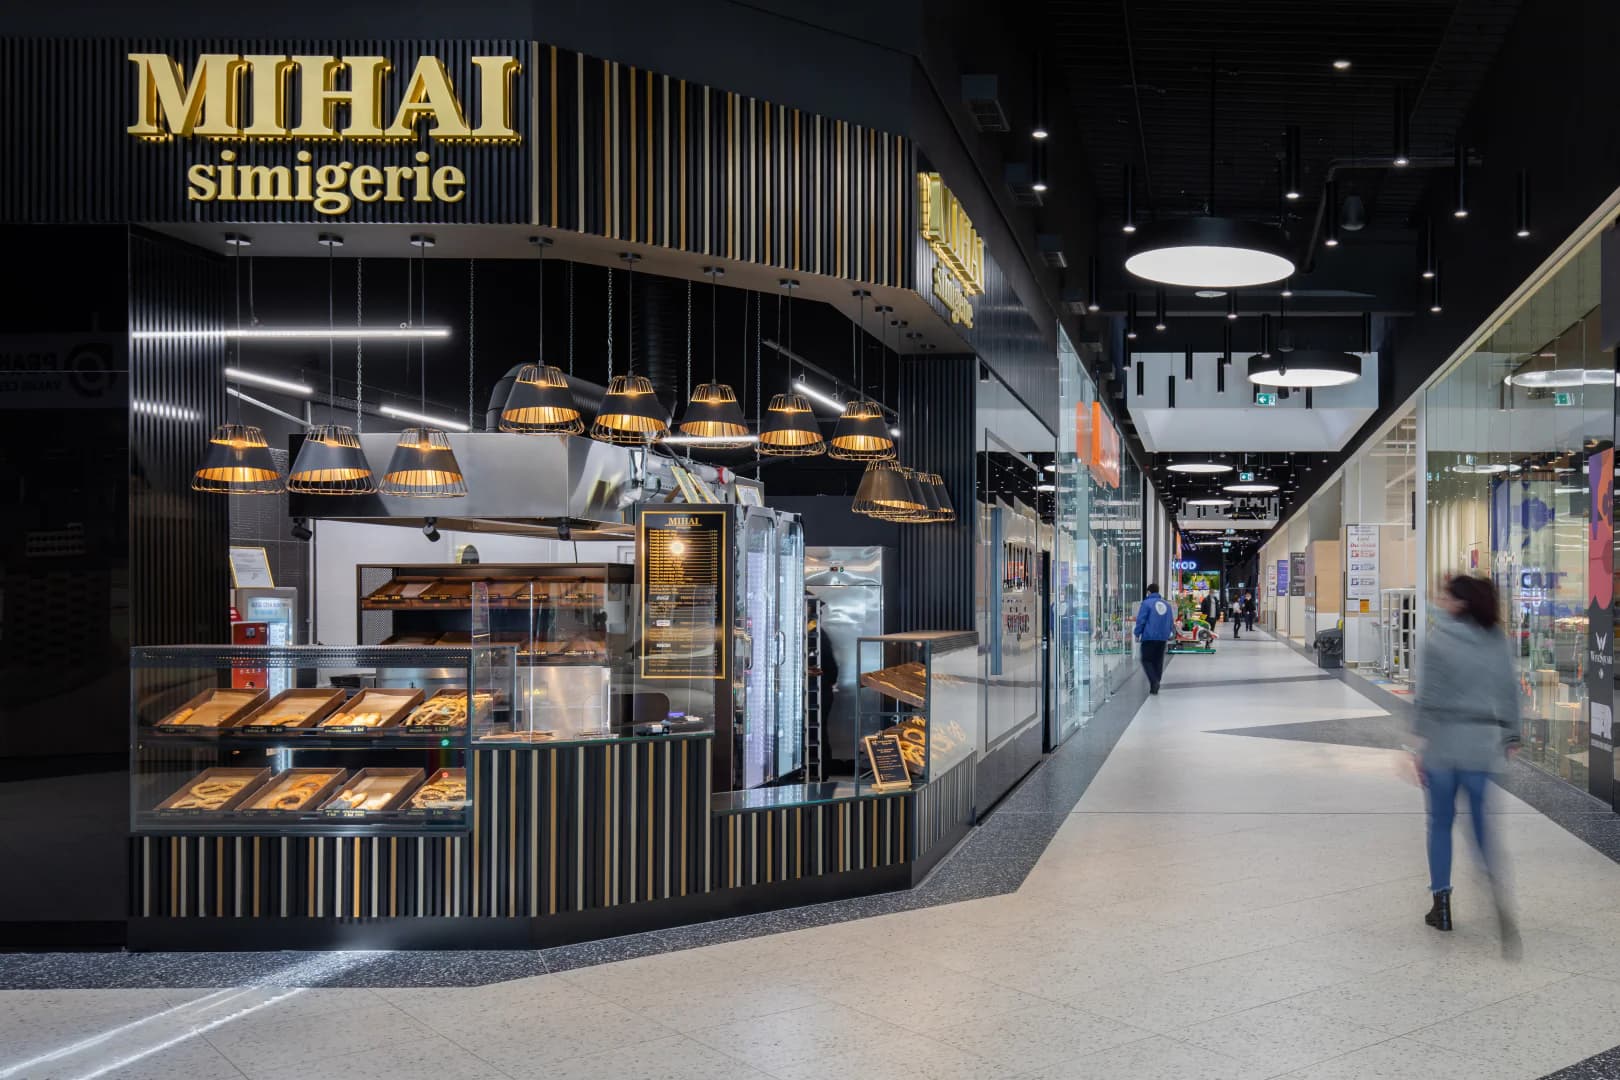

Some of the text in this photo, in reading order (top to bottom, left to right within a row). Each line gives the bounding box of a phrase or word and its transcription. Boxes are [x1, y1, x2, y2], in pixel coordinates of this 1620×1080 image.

[127, 53, 521, 144] MIHAI
[187, 150, 466, 215] simigerie
[668, 517, 700, 526] MIHAI
